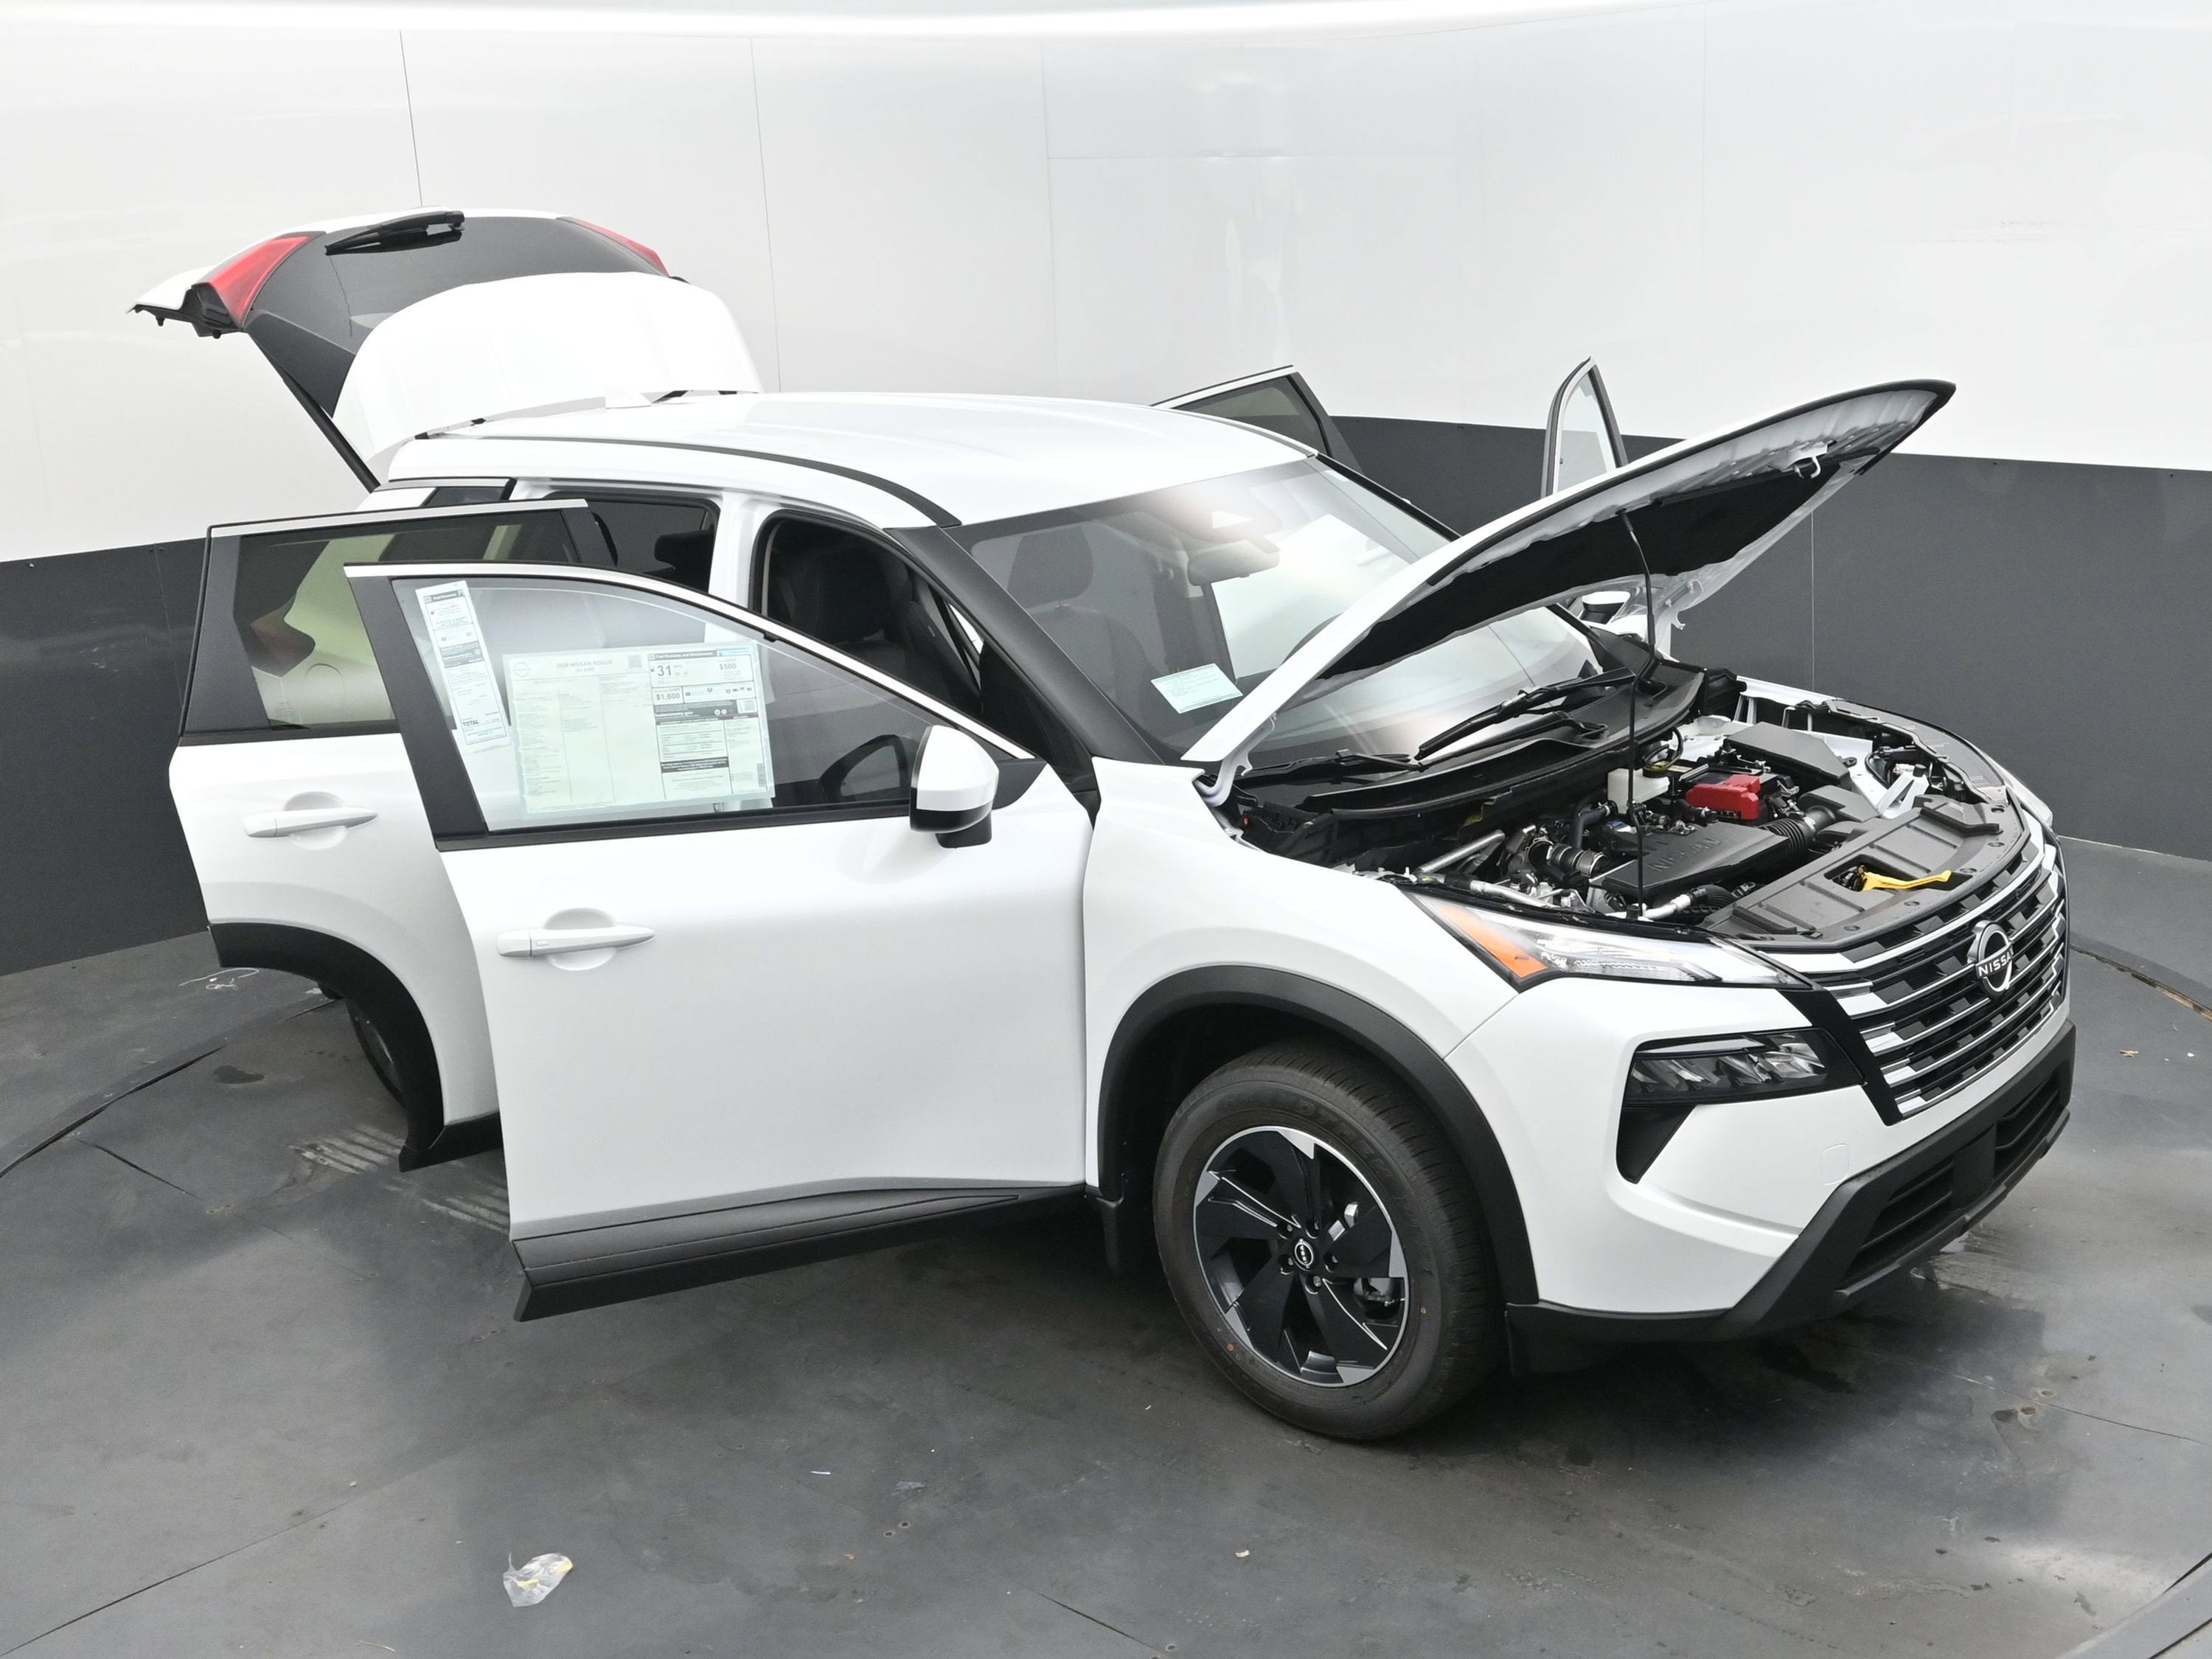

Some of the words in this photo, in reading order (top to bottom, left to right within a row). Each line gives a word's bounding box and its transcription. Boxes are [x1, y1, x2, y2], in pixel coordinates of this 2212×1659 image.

[657, 665, 672, 677] 31
[655, 692, 680, 700] $1,600
[462, 719, 480, 727] TOTAL
